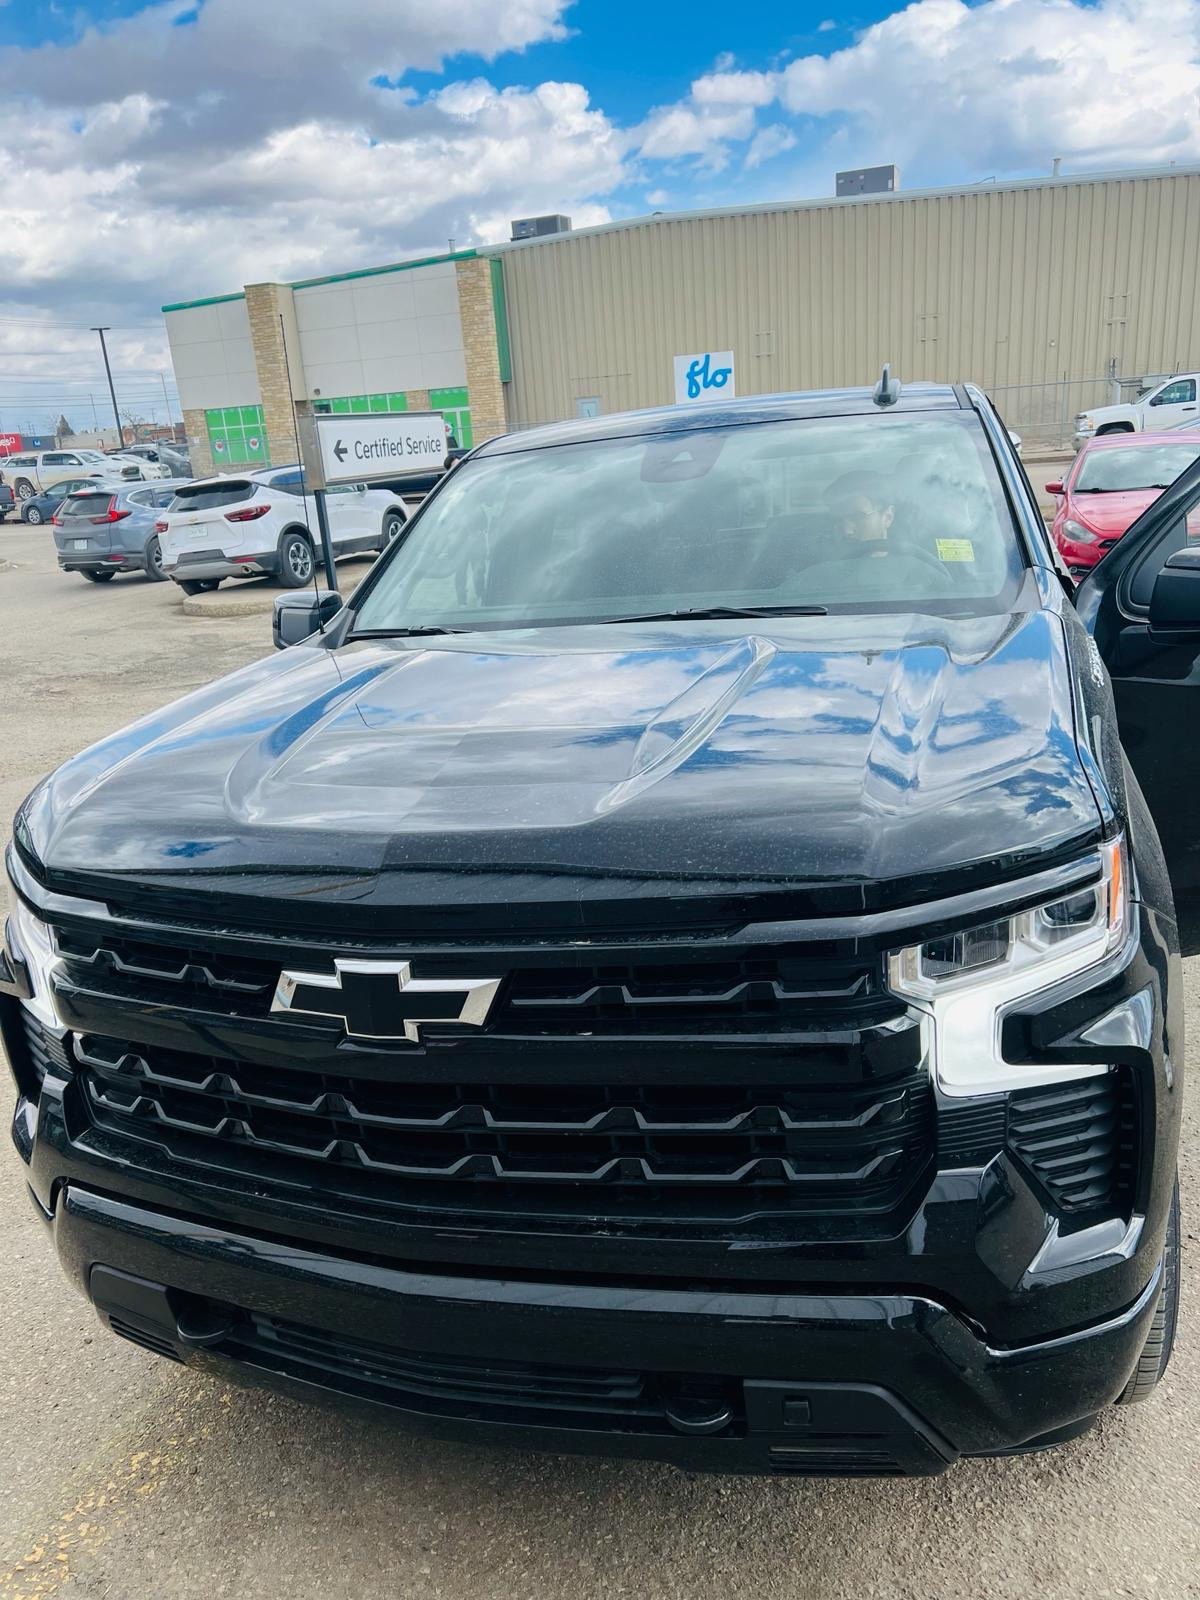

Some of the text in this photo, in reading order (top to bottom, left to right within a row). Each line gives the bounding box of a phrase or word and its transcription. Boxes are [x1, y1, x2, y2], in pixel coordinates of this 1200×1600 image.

[686, 354, 732, 399] flo
[354, 435, 441, 460] Certified Service
